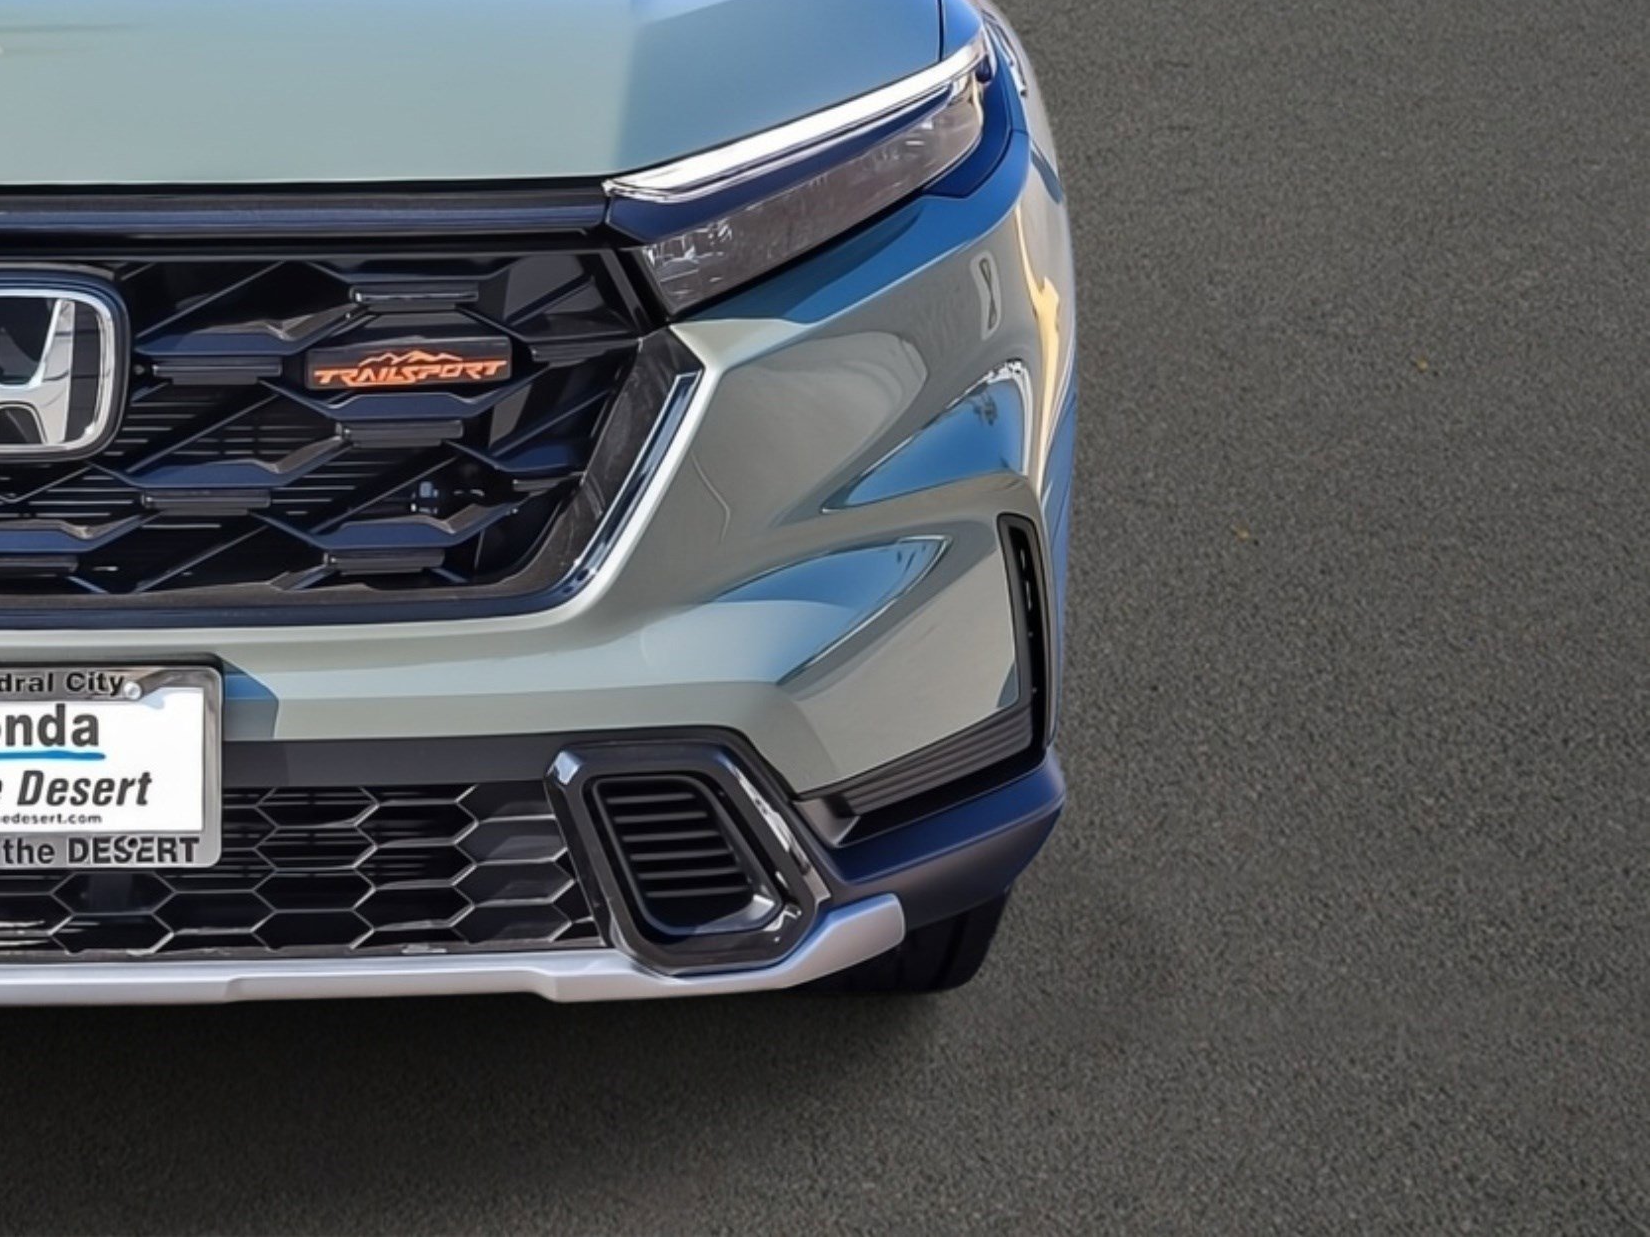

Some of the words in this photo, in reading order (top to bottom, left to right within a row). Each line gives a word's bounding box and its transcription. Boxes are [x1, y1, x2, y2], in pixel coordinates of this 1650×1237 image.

[313, 360, 507, 387] TRAILSPORT
[65, 671, 125, 696] City
[16, 770, 153, 807] Desert
[2, 837, 56, 865] the
[67, 836, 201, 864] DESERT
